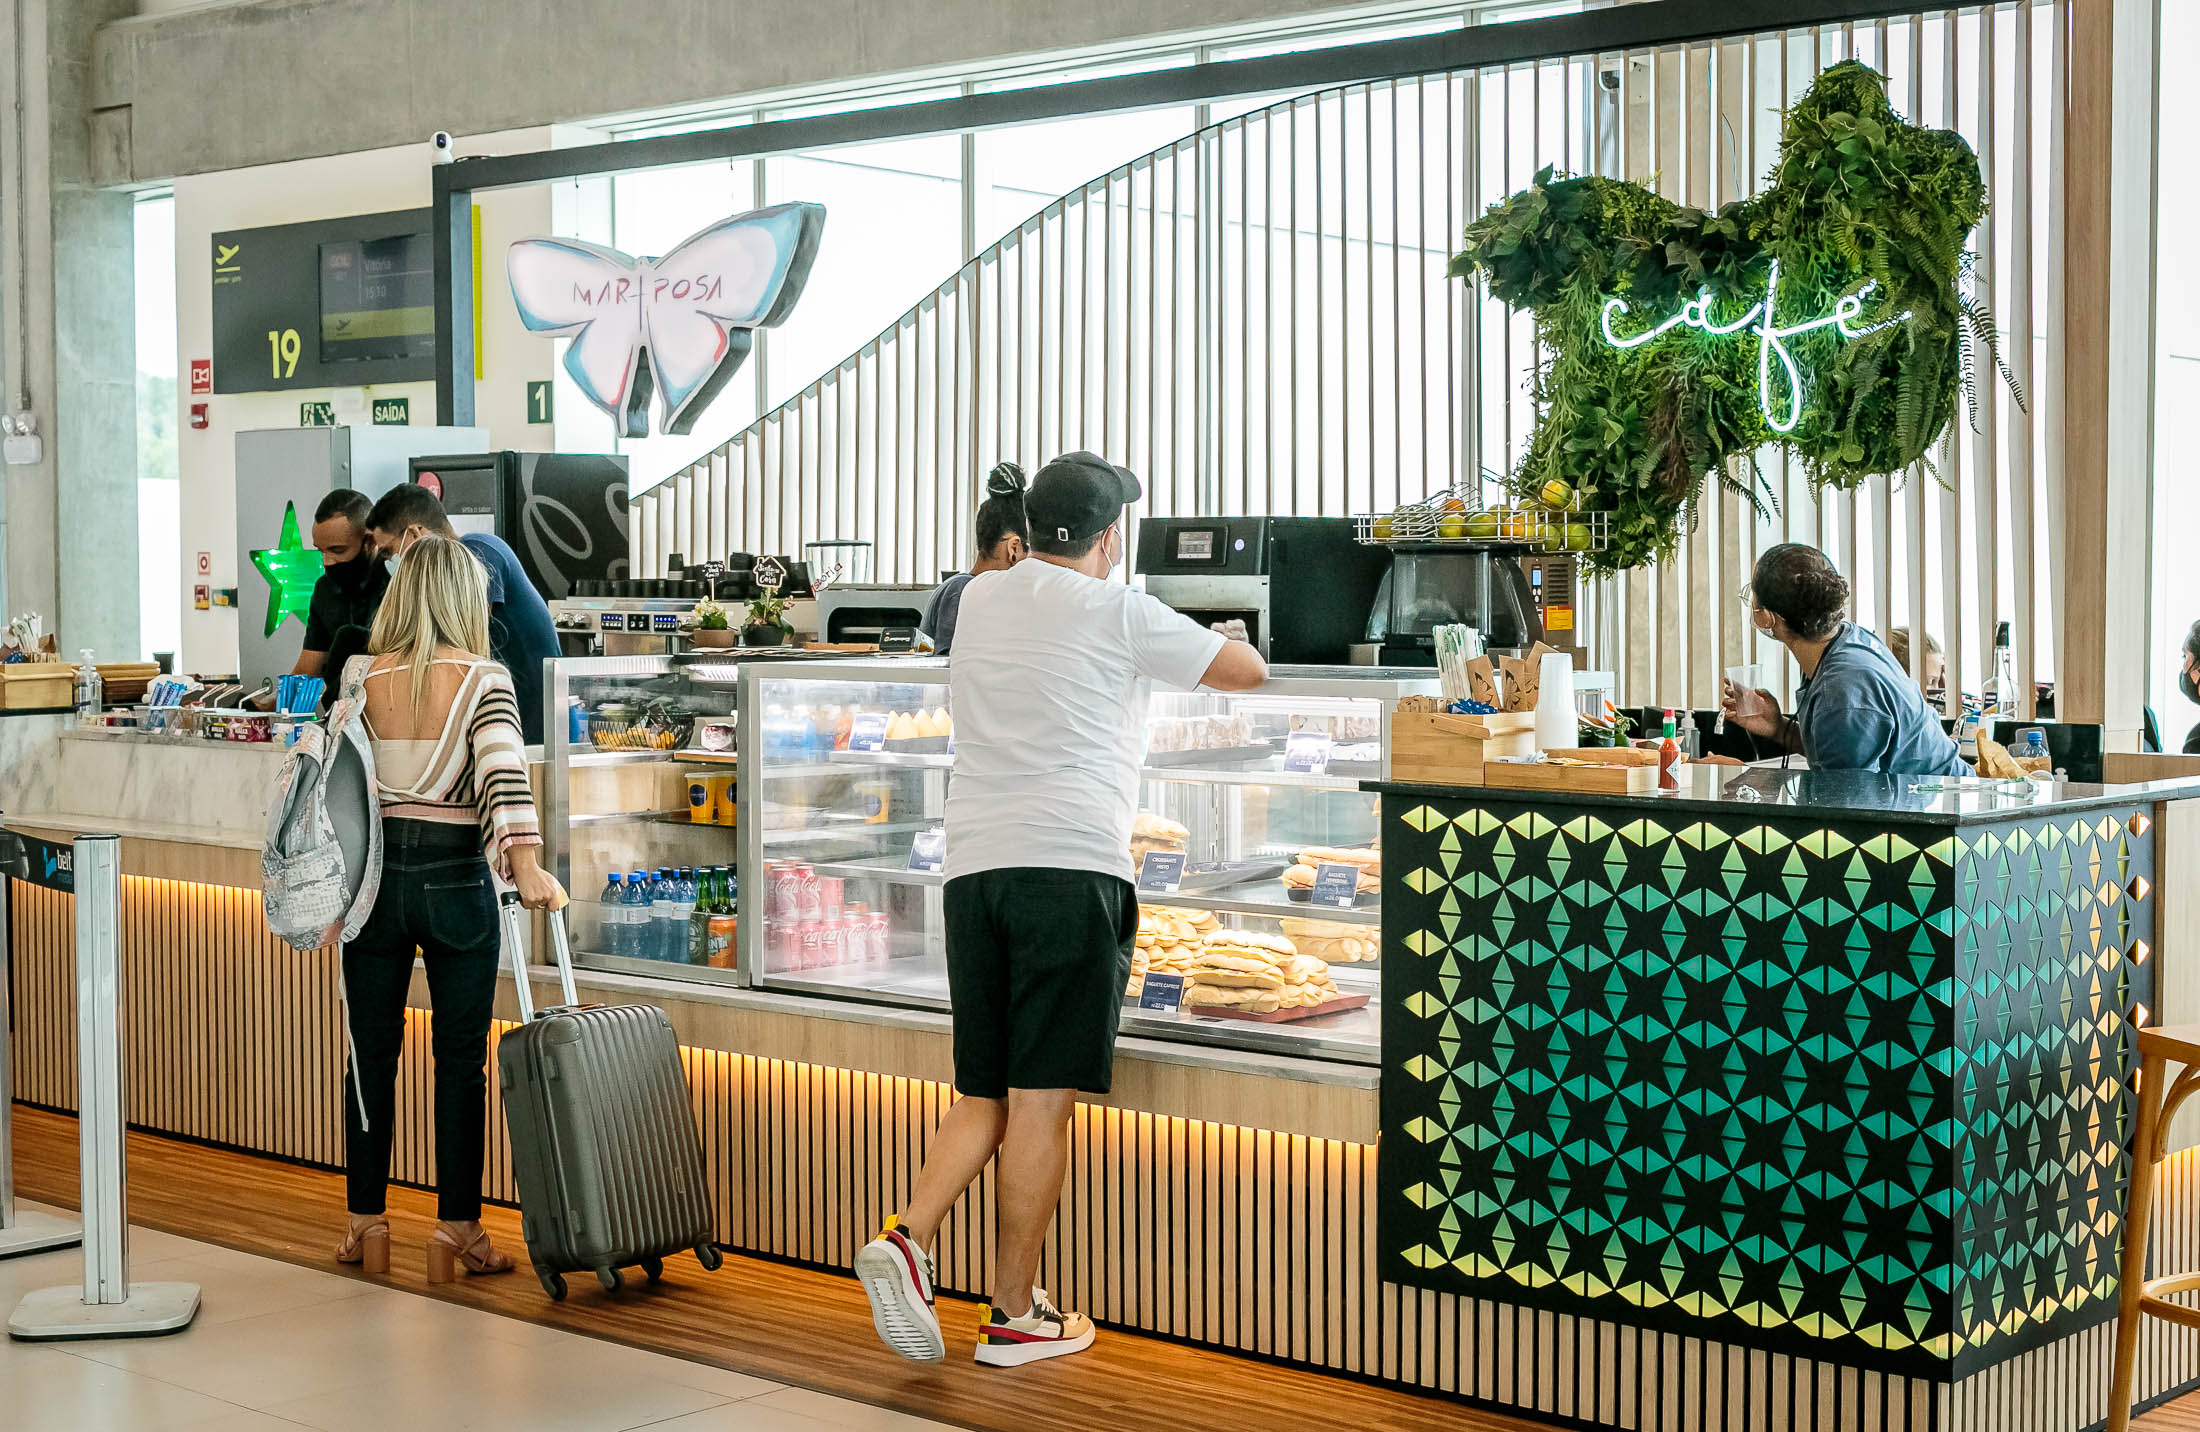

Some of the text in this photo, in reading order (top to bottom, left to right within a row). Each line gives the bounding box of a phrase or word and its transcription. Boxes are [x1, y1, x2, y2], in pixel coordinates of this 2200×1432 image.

[573, 274, 721, 306] MARIPOSA
[268, 328, 302, 380] 19
[374, 402, 407, 422] SAÍDA
[534, 383, 546, 421] 1
